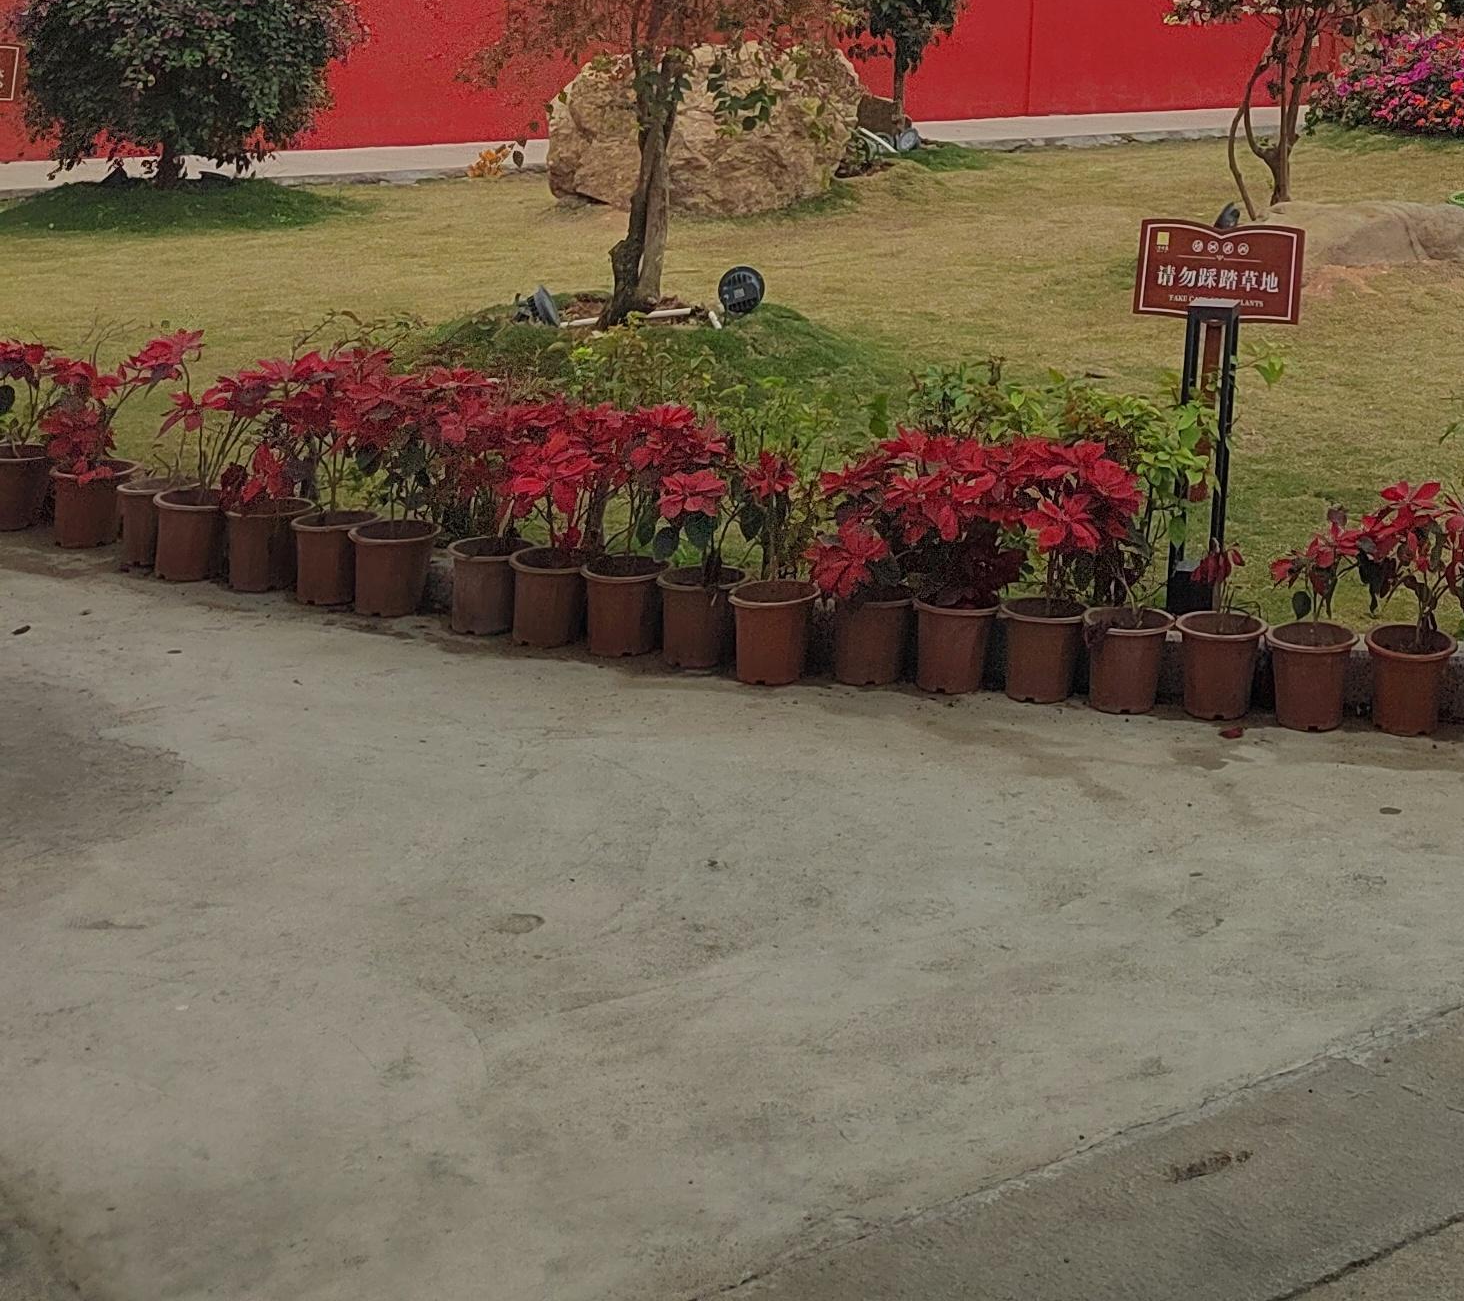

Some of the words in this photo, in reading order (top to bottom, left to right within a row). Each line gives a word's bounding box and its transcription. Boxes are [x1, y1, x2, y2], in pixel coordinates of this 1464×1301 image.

[1157, 265, 1279, 293] 请勿踩踏草地
[1240, 300, 1264, 308] LANTS
